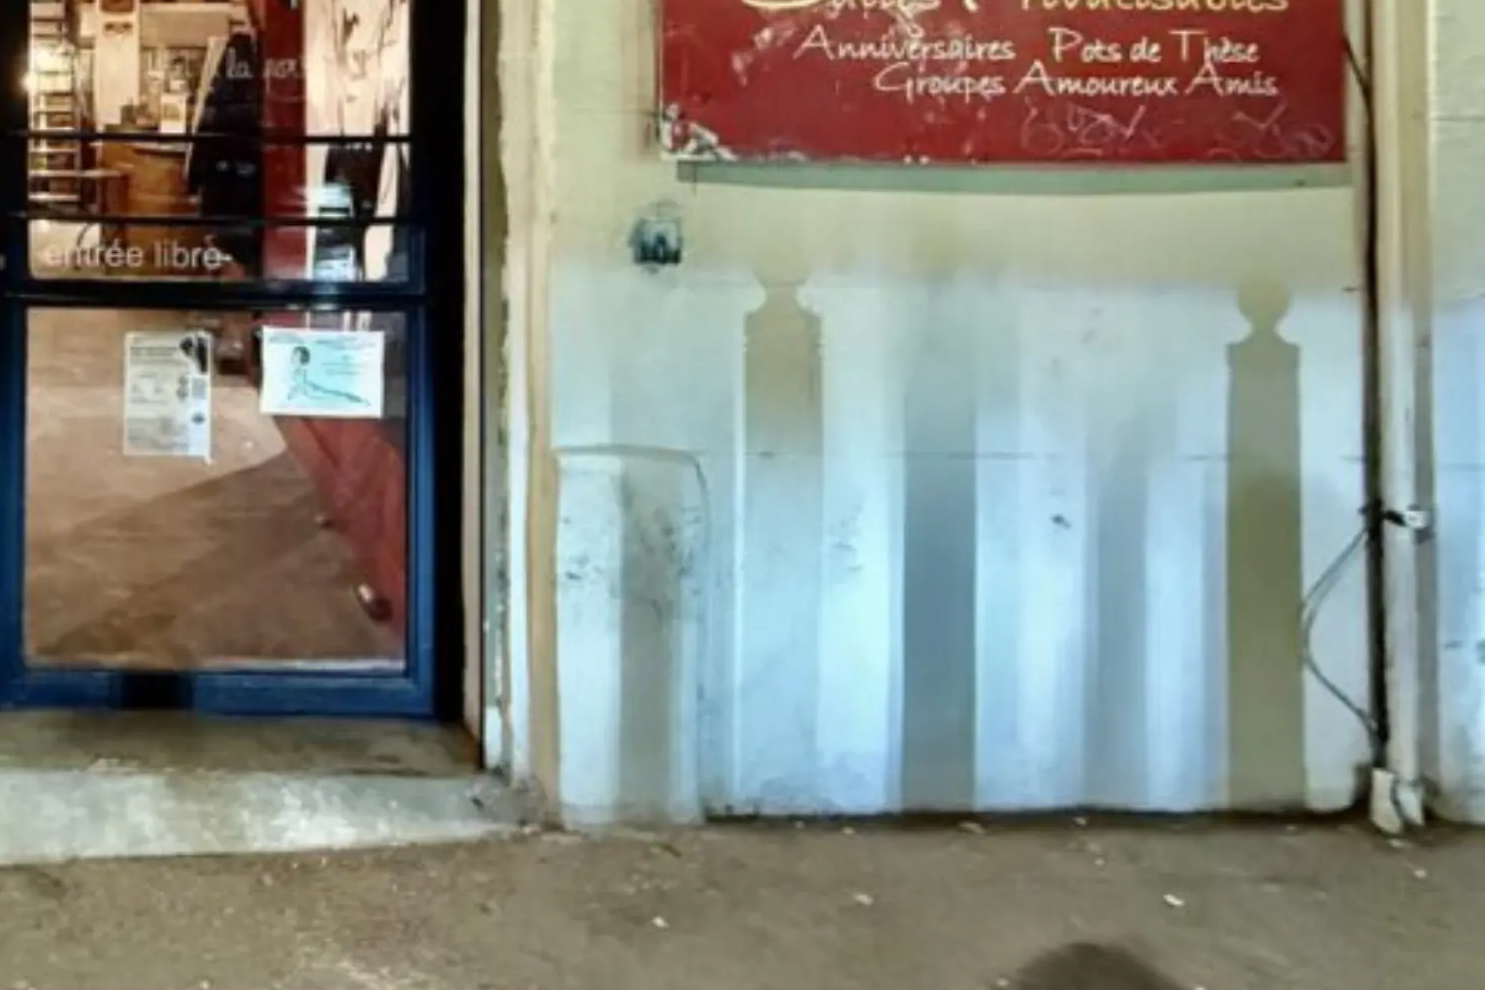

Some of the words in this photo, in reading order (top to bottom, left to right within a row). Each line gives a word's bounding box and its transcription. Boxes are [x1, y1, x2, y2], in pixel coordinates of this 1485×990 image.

[792, 24, 1017, 62] Anniversaires
[1047, 26, 1122, 62] Pots
[1129, 36, 1162, 62] de
[874, 61, 1007, 104] Groupes
[1013, 59, 1177, 96] Amoureux
[1185, 61, 1279, 97] Amis
